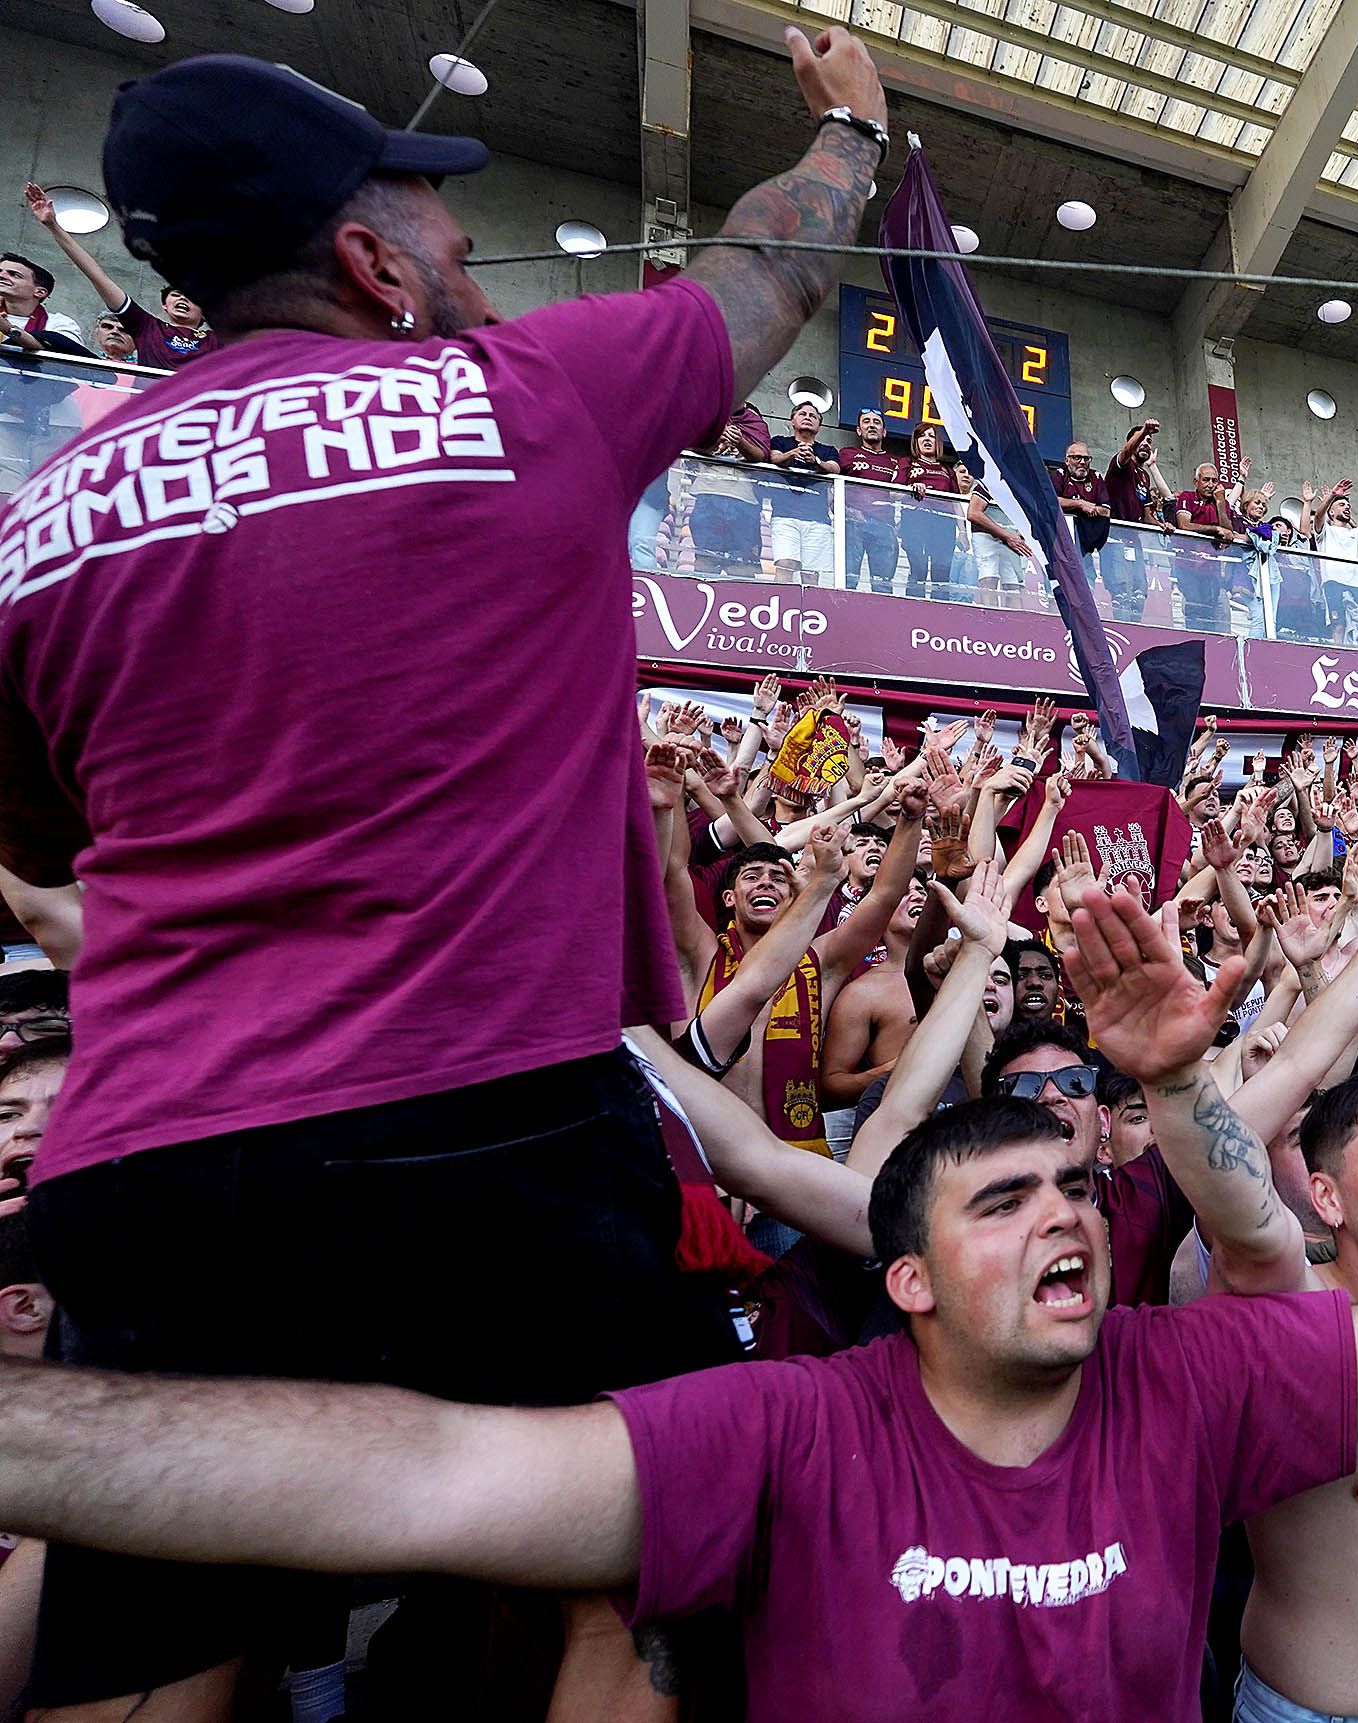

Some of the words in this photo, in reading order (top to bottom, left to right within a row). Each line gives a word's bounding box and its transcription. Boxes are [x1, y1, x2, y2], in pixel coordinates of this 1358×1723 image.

[866, 311, 895, 353] 2
[1022, 345, 1047, 385] 2
[1213, 416, 1230, 482] Deputación
[0, 437, 271, 606] SOMOS
[303, 397, 506, 479] NOS
[910, 628, 1056, 663] Pontevedra
[1108, 860, 1153, 879] ONTEVEDRA
[922, 1541, 1127, 1604] PONTEVEDRA
